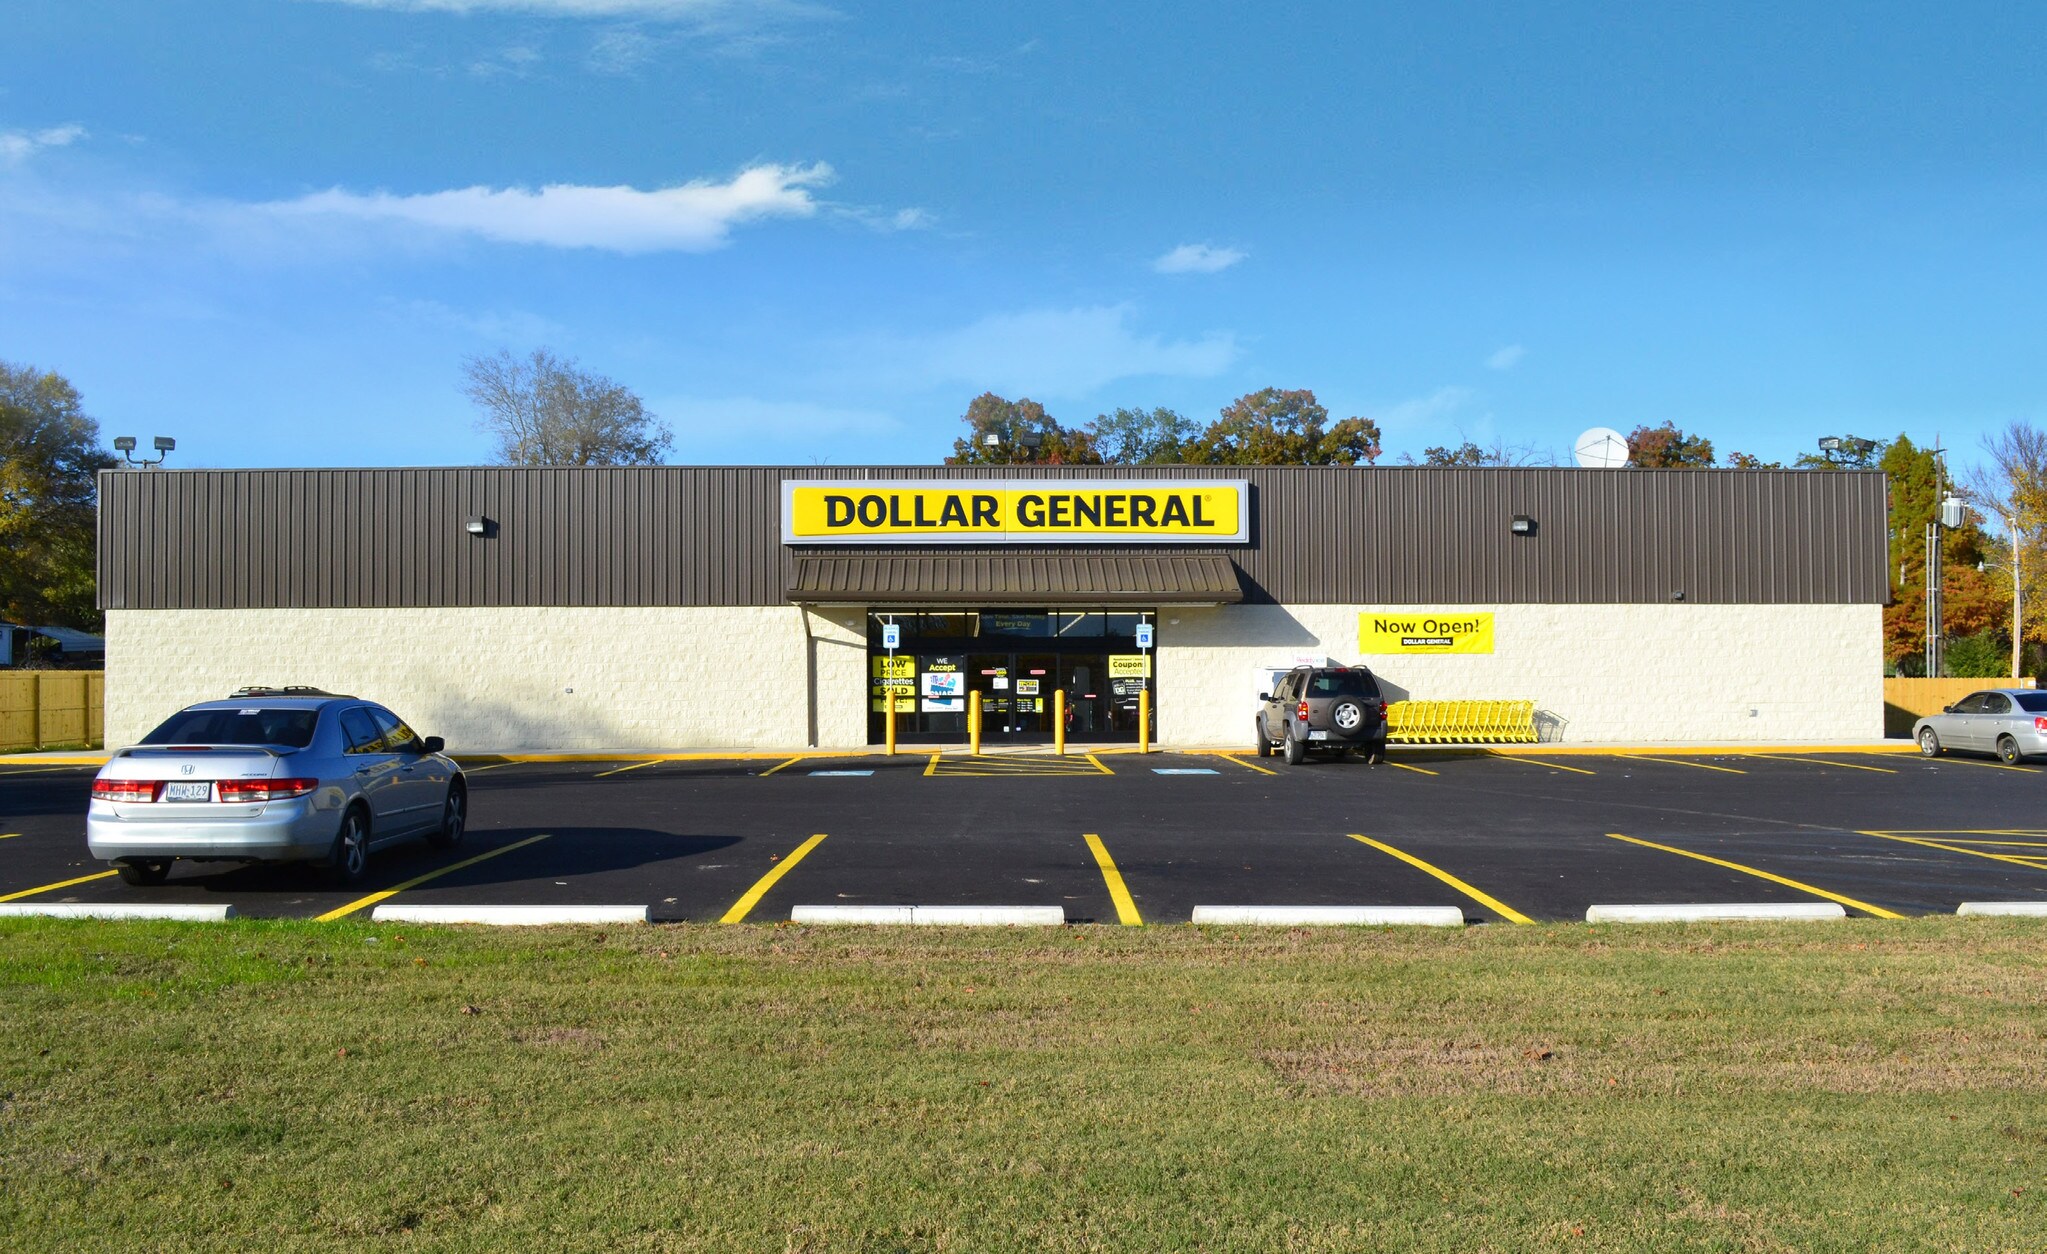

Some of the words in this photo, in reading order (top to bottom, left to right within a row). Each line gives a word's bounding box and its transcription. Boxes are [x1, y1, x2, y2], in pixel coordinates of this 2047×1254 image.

[824, 494, 1000, 528] DOLLAR
[1016, 494, 1215, 528] GENERAL
[995, 620, 1016, 628] Every
[1017, 620, 1032, 628] Day
[1374, 619, 1416, 634] Now
[1423, 618, 1480, 636] Open!
[936, 657, 948, 665] WE
[1113, 661, 1147, 670] Coupon
[929, 664, 956, 673] Accept
